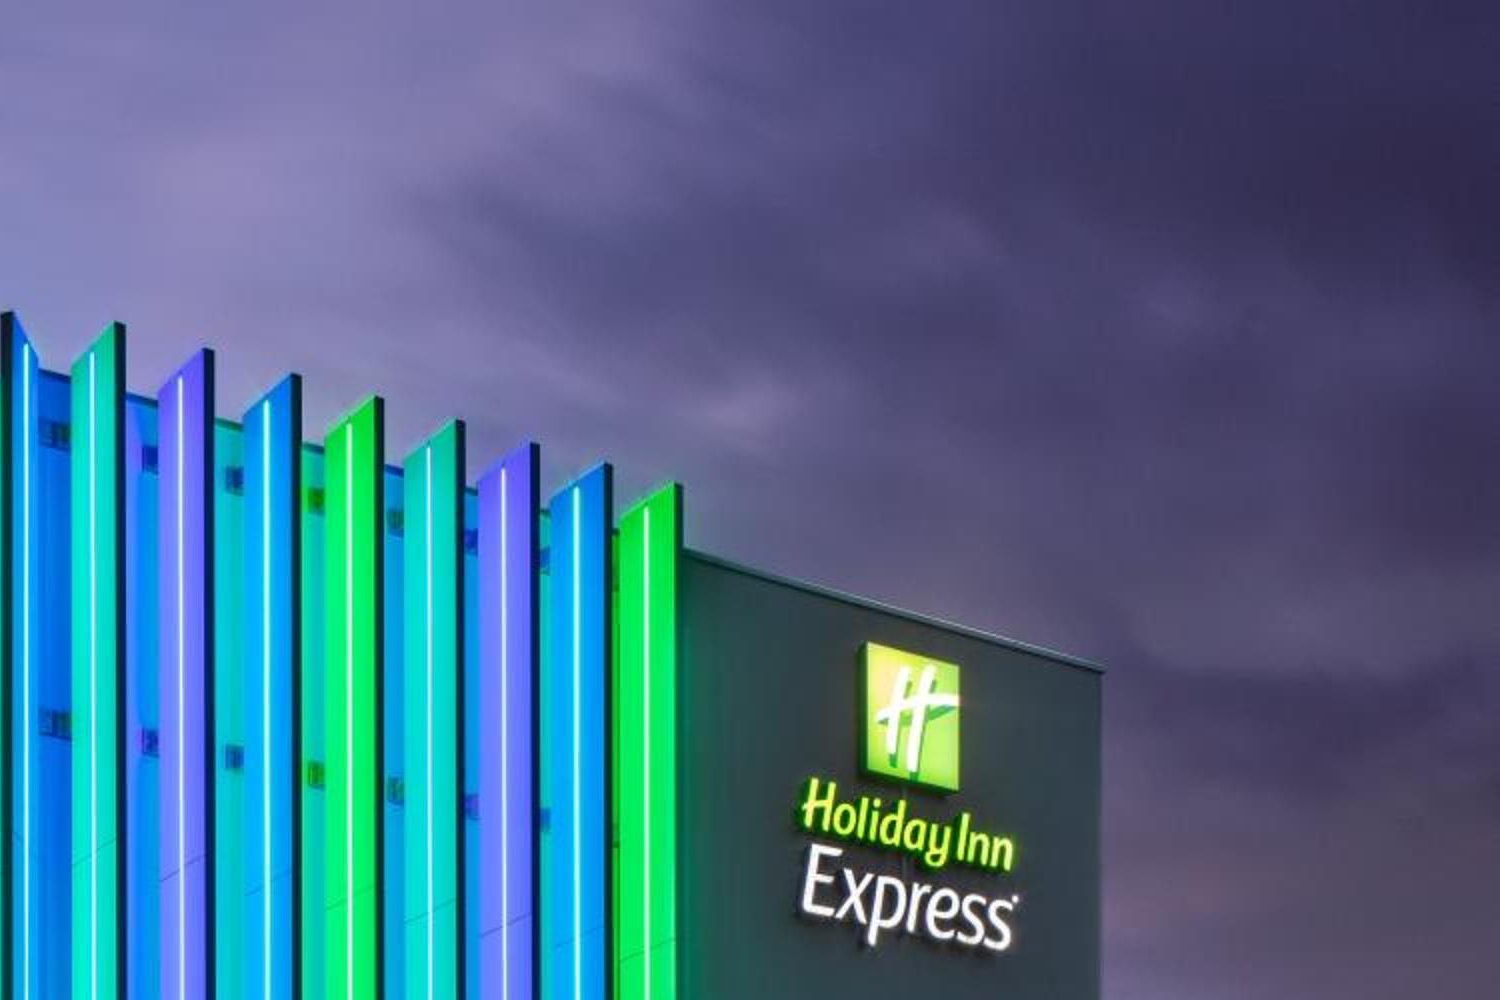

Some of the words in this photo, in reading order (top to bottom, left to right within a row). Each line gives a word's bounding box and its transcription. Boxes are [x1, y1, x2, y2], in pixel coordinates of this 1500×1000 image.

[802, 777, 950, 868] Holiday
[958, 812, 1014, 872] Inn
[802, 843, 1012, 951] Express
